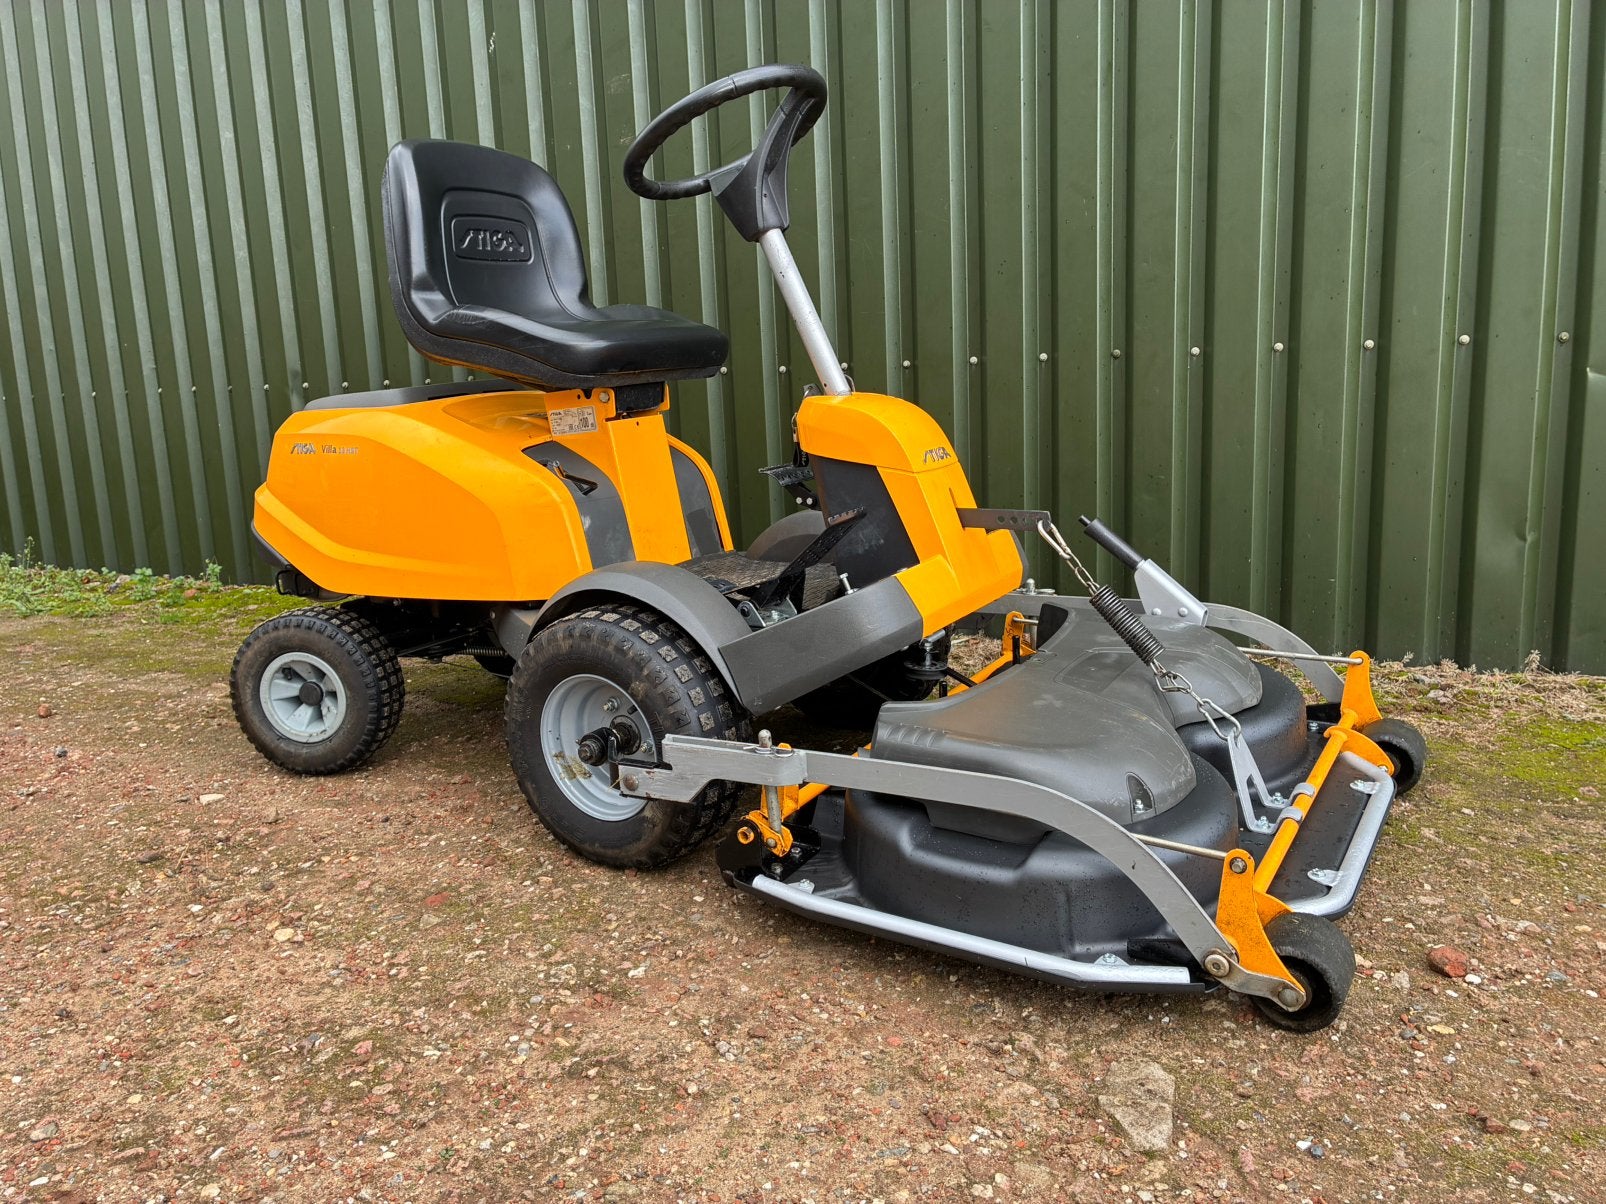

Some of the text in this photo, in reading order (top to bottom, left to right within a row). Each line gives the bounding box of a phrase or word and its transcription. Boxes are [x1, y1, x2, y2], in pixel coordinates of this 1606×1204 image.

[460, 229, 525, 252] STIGA
[290, 443, 316, 455] STIGA
[321, 444, 337, 454] Villa
[924, 447, 951, 463] STIGA
